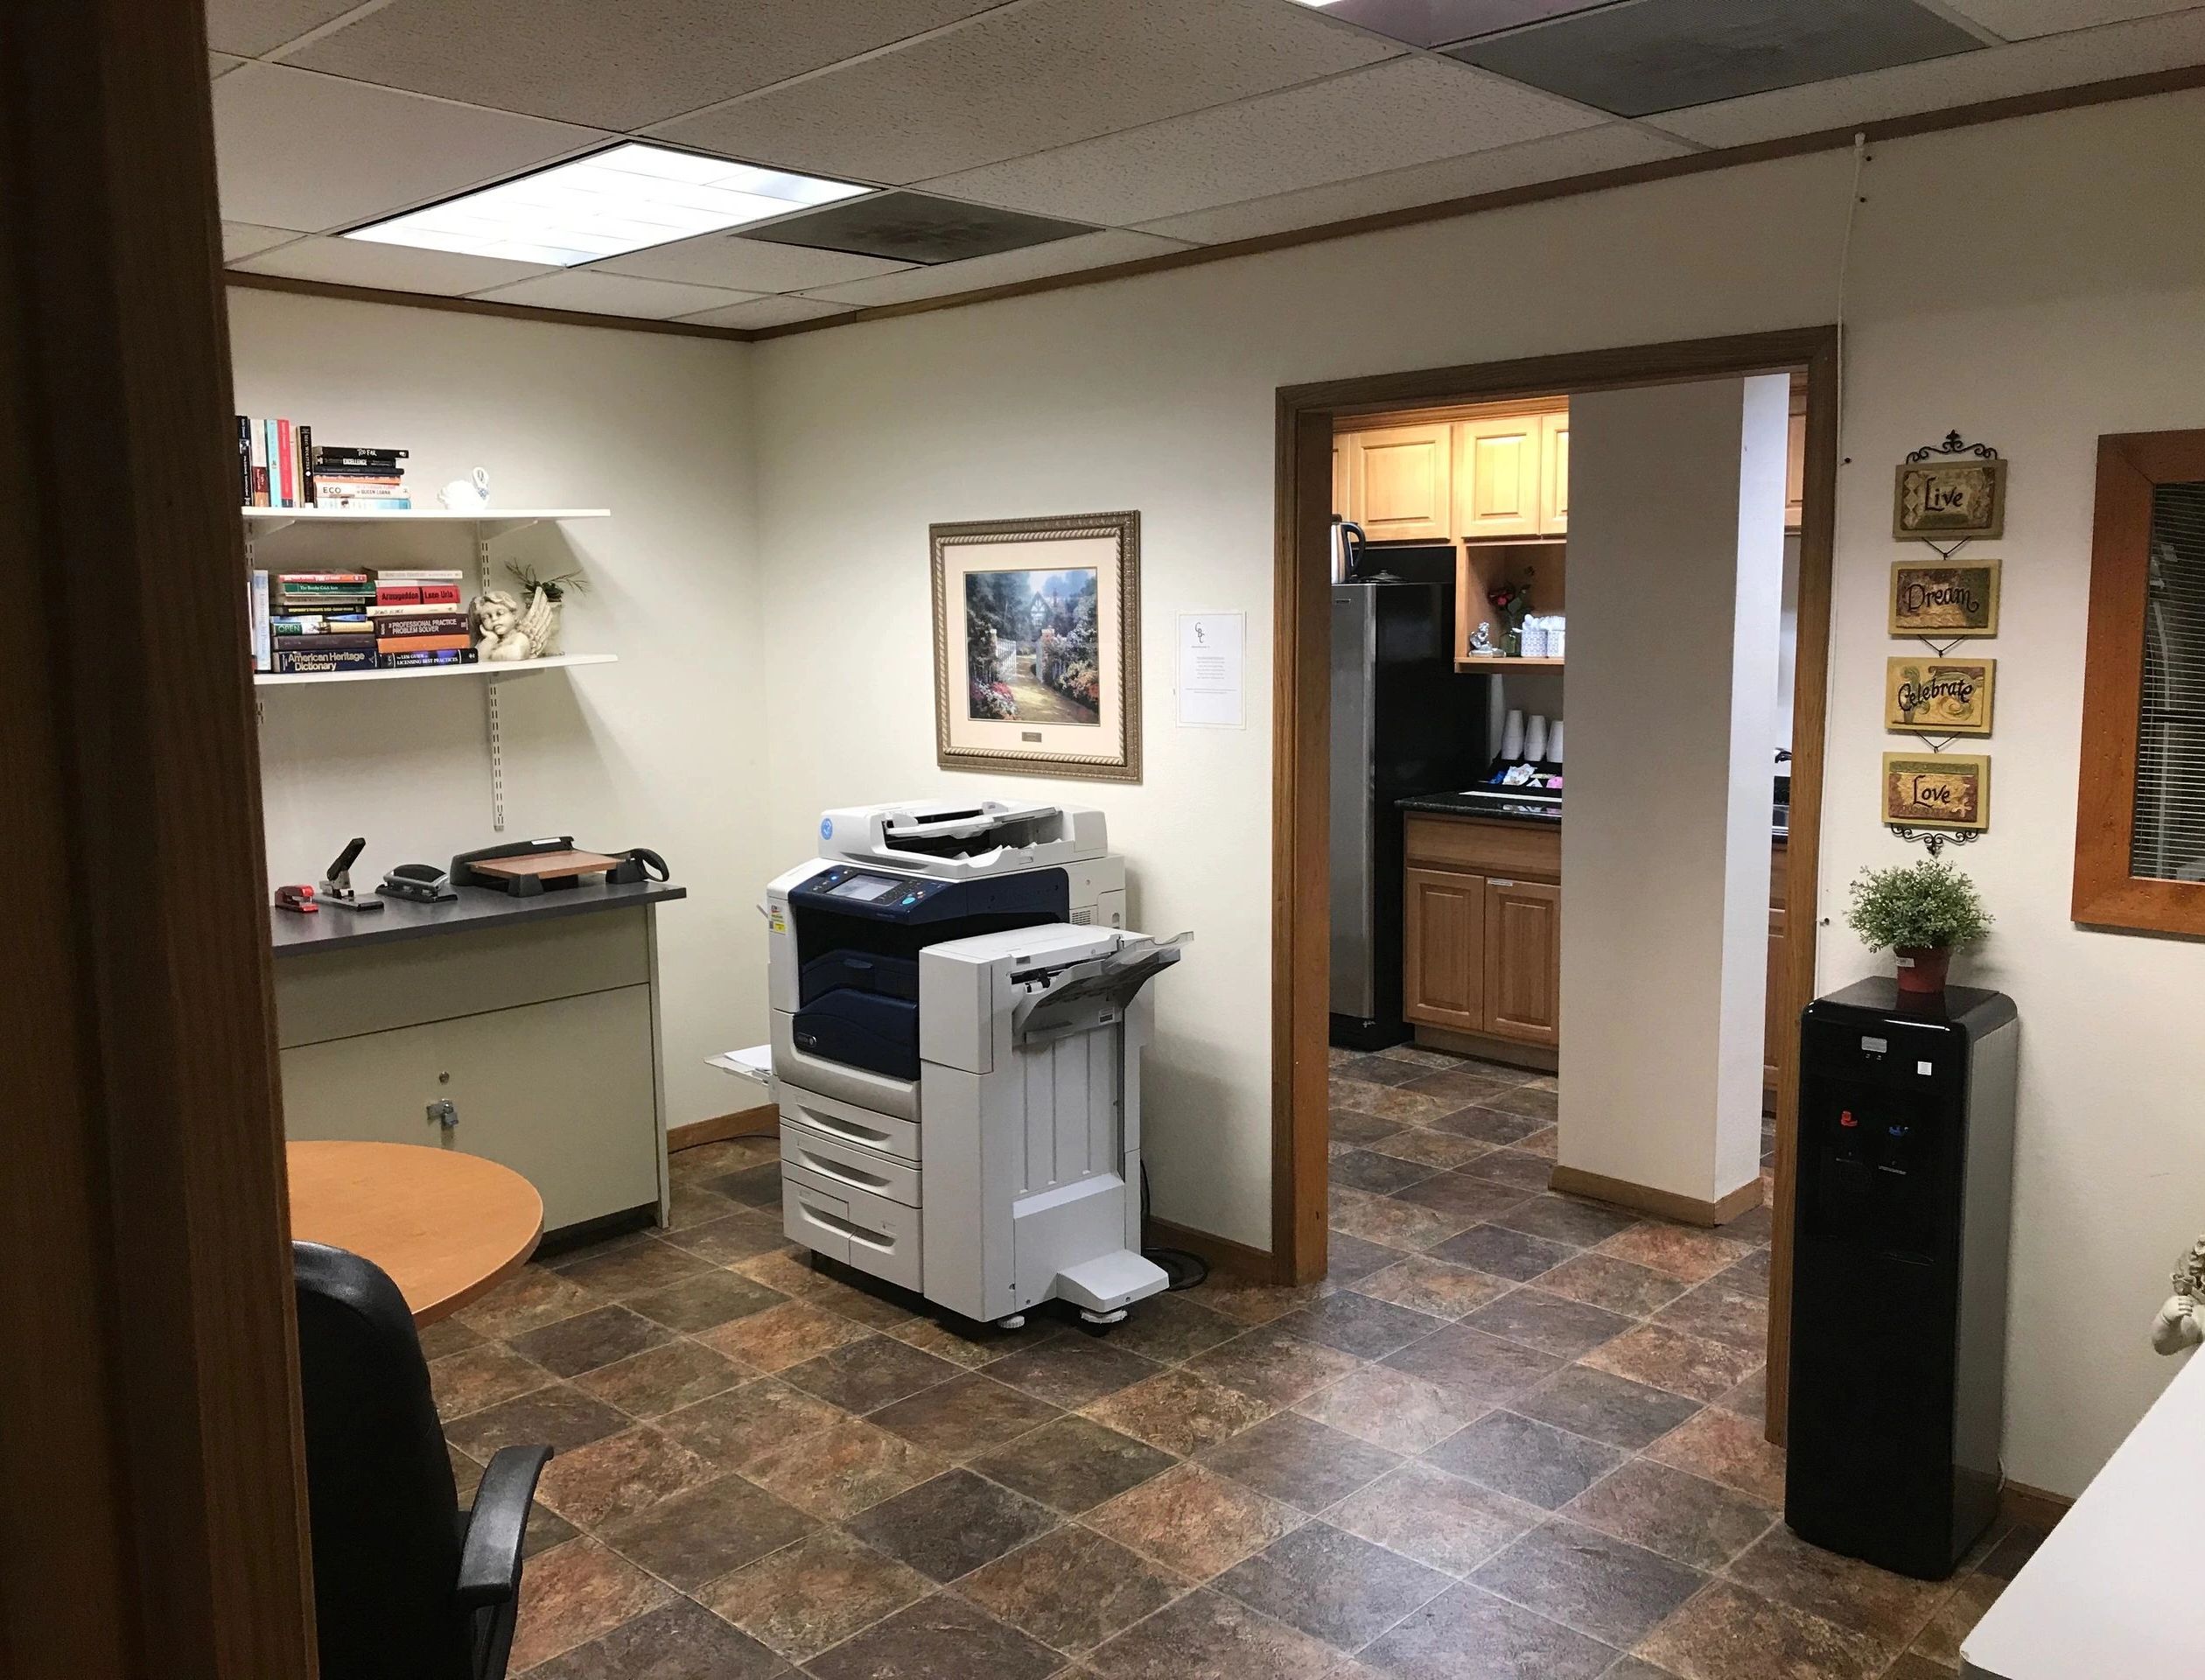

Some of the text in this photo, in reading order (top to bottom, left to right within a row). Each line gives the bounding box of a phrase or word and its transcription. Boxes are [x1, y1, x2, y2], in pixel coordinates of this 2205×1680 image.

[1923, 477, 1964, 514] Live
[382, 591, 419, 601] Armageddon
[1908, 581, 1980, 615] Dream
[278, 624, 300, 633] OPEN
[288, 652, 365, 662] American Heritage
[294, 662, 337, 672] Dictionary
[1898, 681, 1974, 714] Celebrate
[1913, 774, 1951, 807] Love
